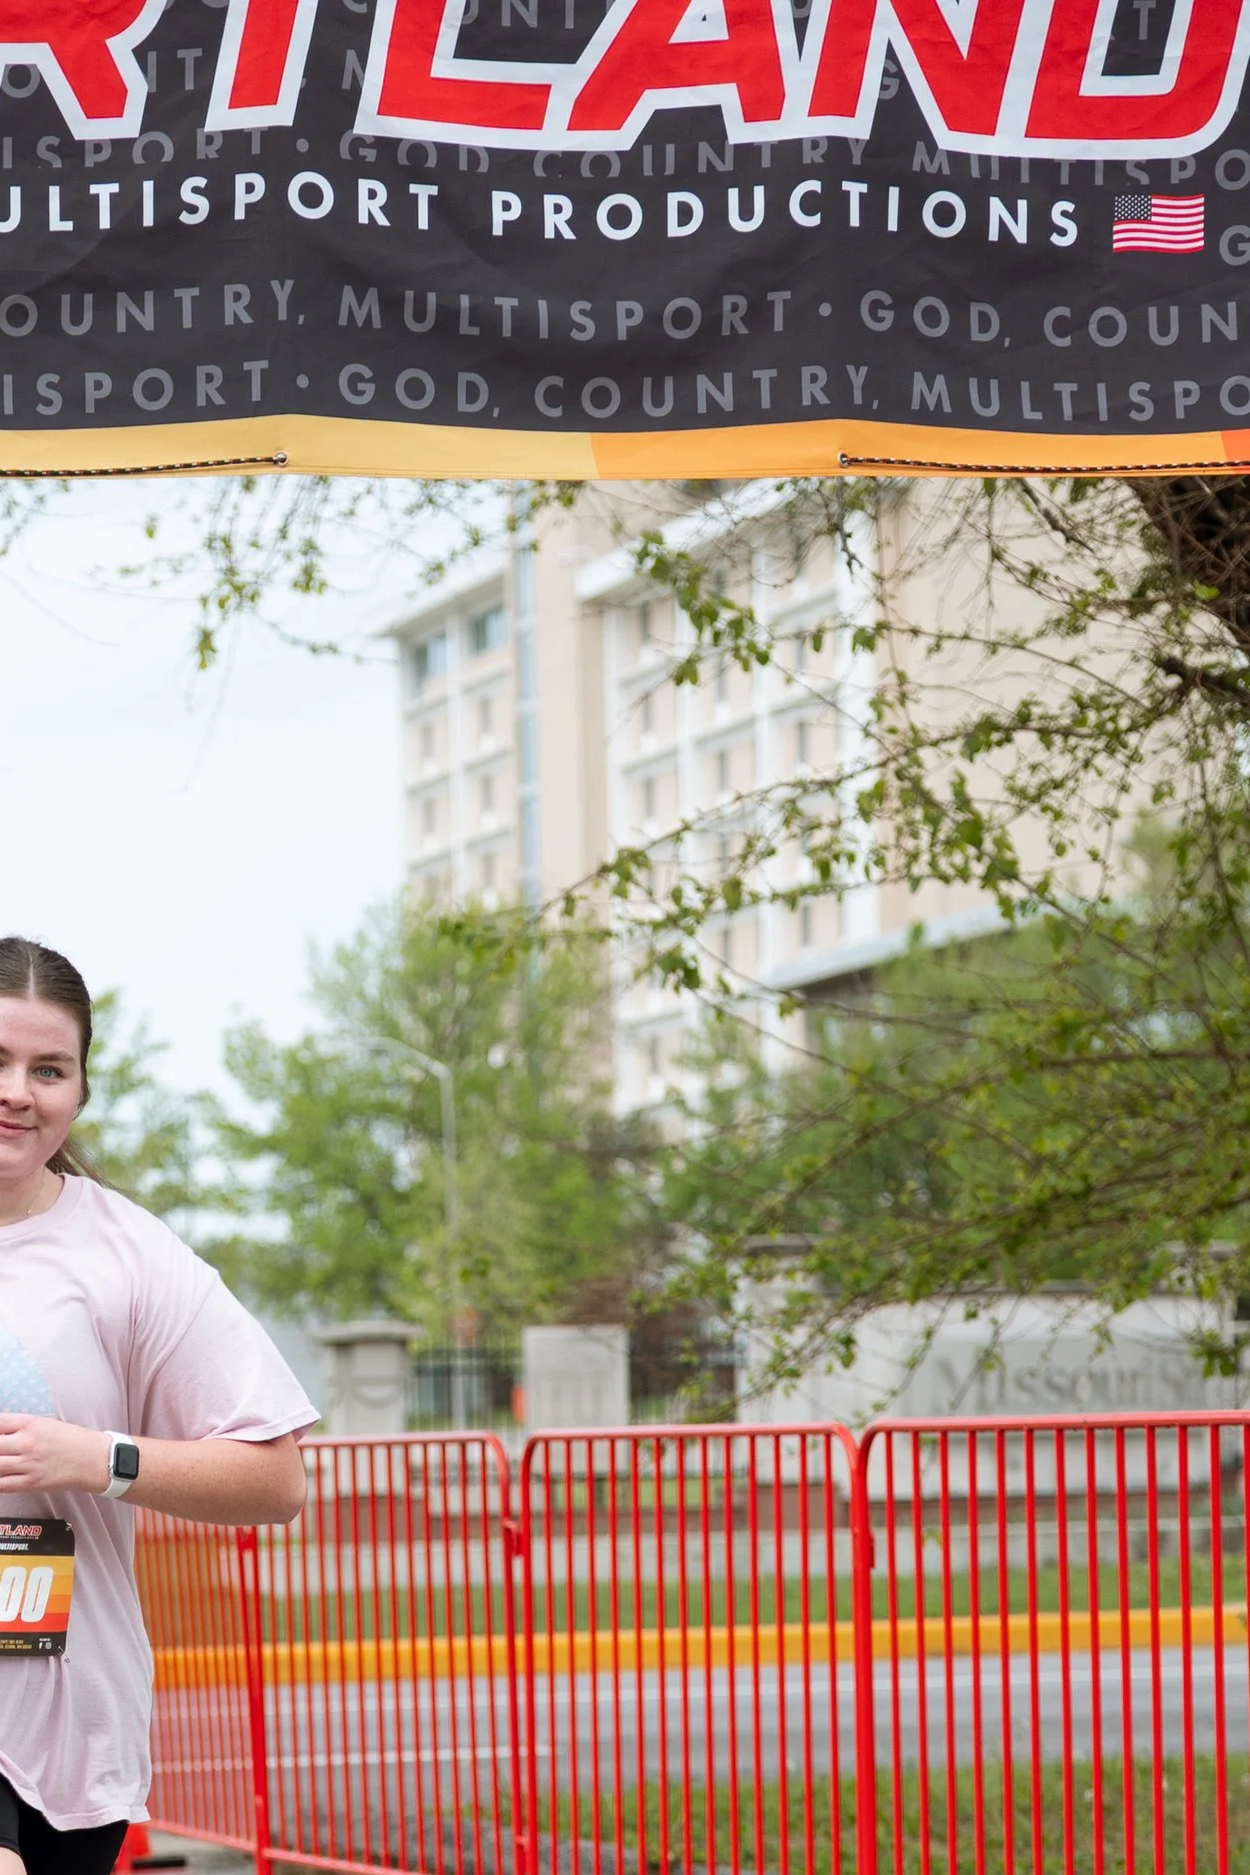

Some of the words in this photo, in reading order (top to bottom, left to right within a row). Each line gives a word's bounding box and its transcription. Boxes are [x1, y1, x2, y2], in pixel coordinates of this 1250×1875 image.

[492, 180, 1077, 247] PRODUCTIONS
[338, 285, 792, 341] MULTISPORT
[860, 290, 1010, 347] GOD,
[339, 363, 500, 416] GOD,
[535, 365, 878, 417] COUNTRY,
